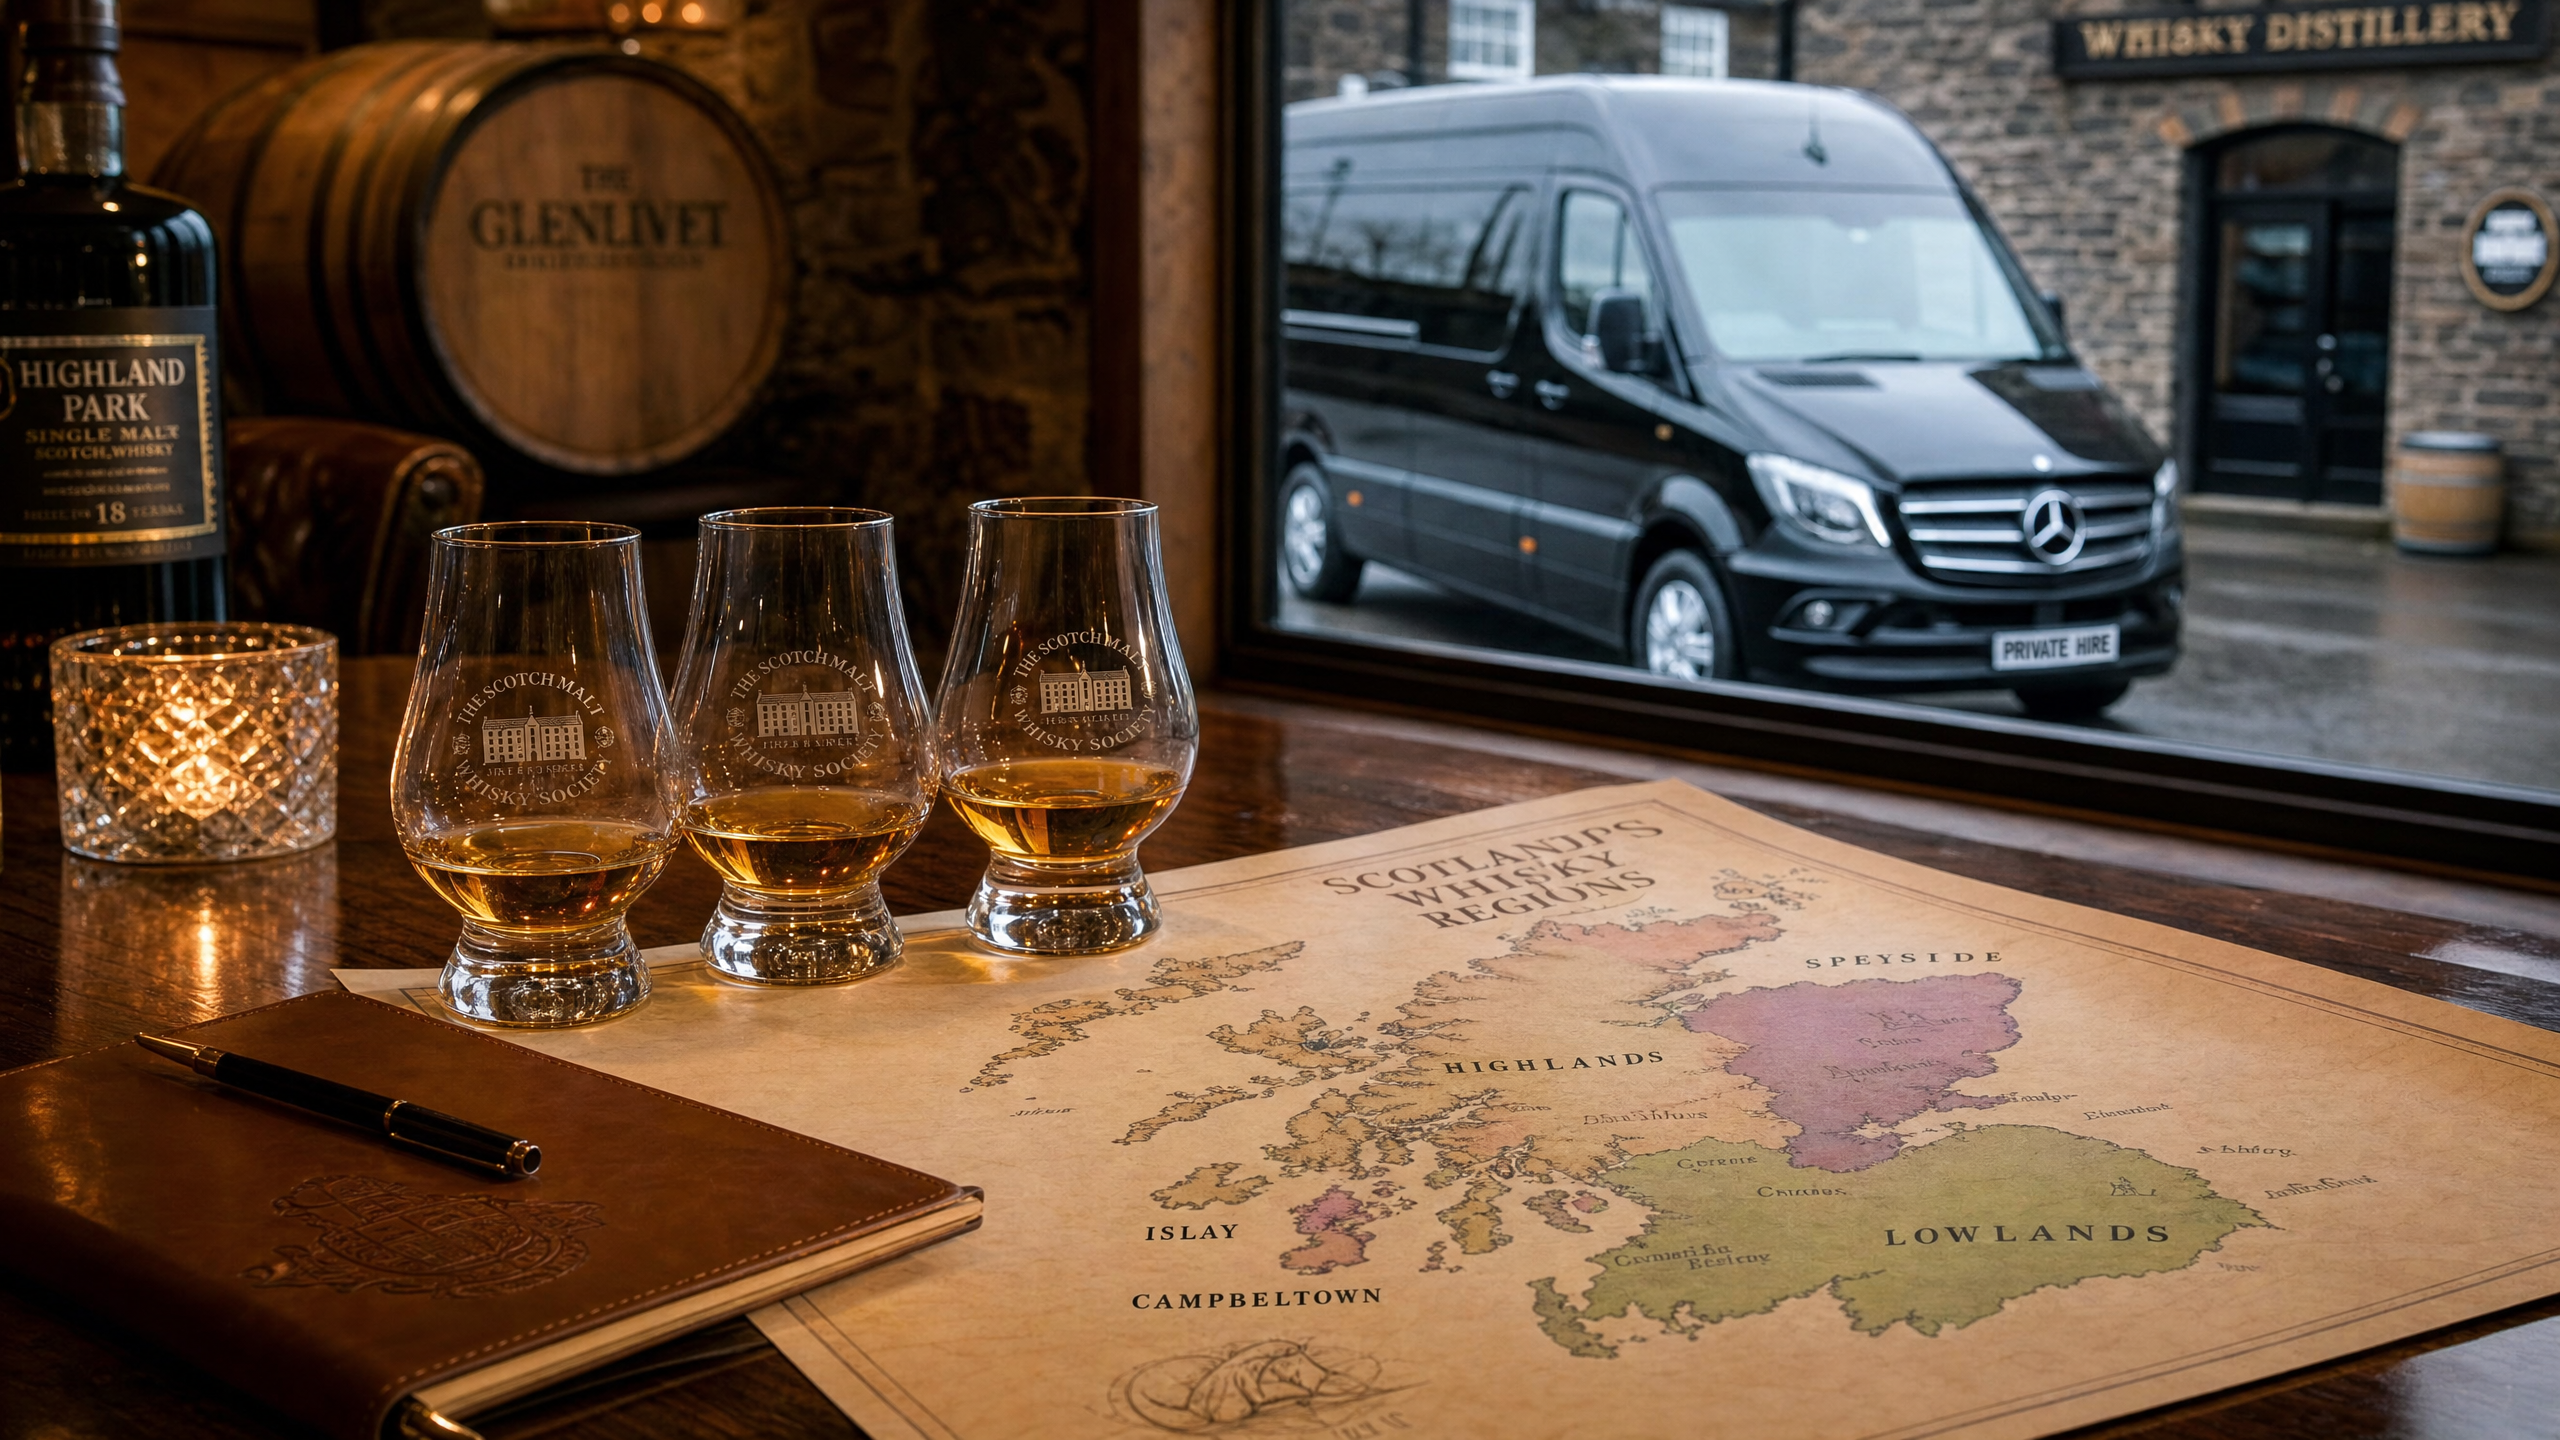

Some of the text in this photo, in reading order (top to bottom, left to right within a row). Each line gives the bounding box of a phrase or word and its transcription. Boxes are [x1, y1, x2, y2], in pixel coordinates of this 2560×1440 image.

[2078, 3, 2520, 60] WHISKY DISTILLERY
[19, 358, 186, 388] HIGHLAND
[62, 393, 151, 422] PARK
[25, 427, 112, 444] SINGLE
[96, 501, 126, 525] 18
[1013, 631, 1150, 678] THE SCOTCH MALT
[2004, 634, 2111, 661] PRIVATE HIRE
[730, 650, 877, 699] THE SCOTCH MALT
[456, 671, 605, 725] THE SCOTCH MALT
[1014, 704, 1156, 751] WHISKY SOCIETY
[730, 728, 885, 779] WHISKY SOCIETY
[456, 753, 613, 806] WHISKY SOCIETY
[1386, 850, 1626, 909] WHISKY
[1418, 870, 1656, 929] REGIONS
[1805, 951, 2003, 970] SPEYSIDE
[1445, 1051, 1664, 1075] HIGHLANDS
[1145, 1223, 1239, 1241] ISLAY
[1884, 1224, 2170, 1246] LOWLANDS
[1131, 1287, 1382, 1310] CAMPBELTOWN
